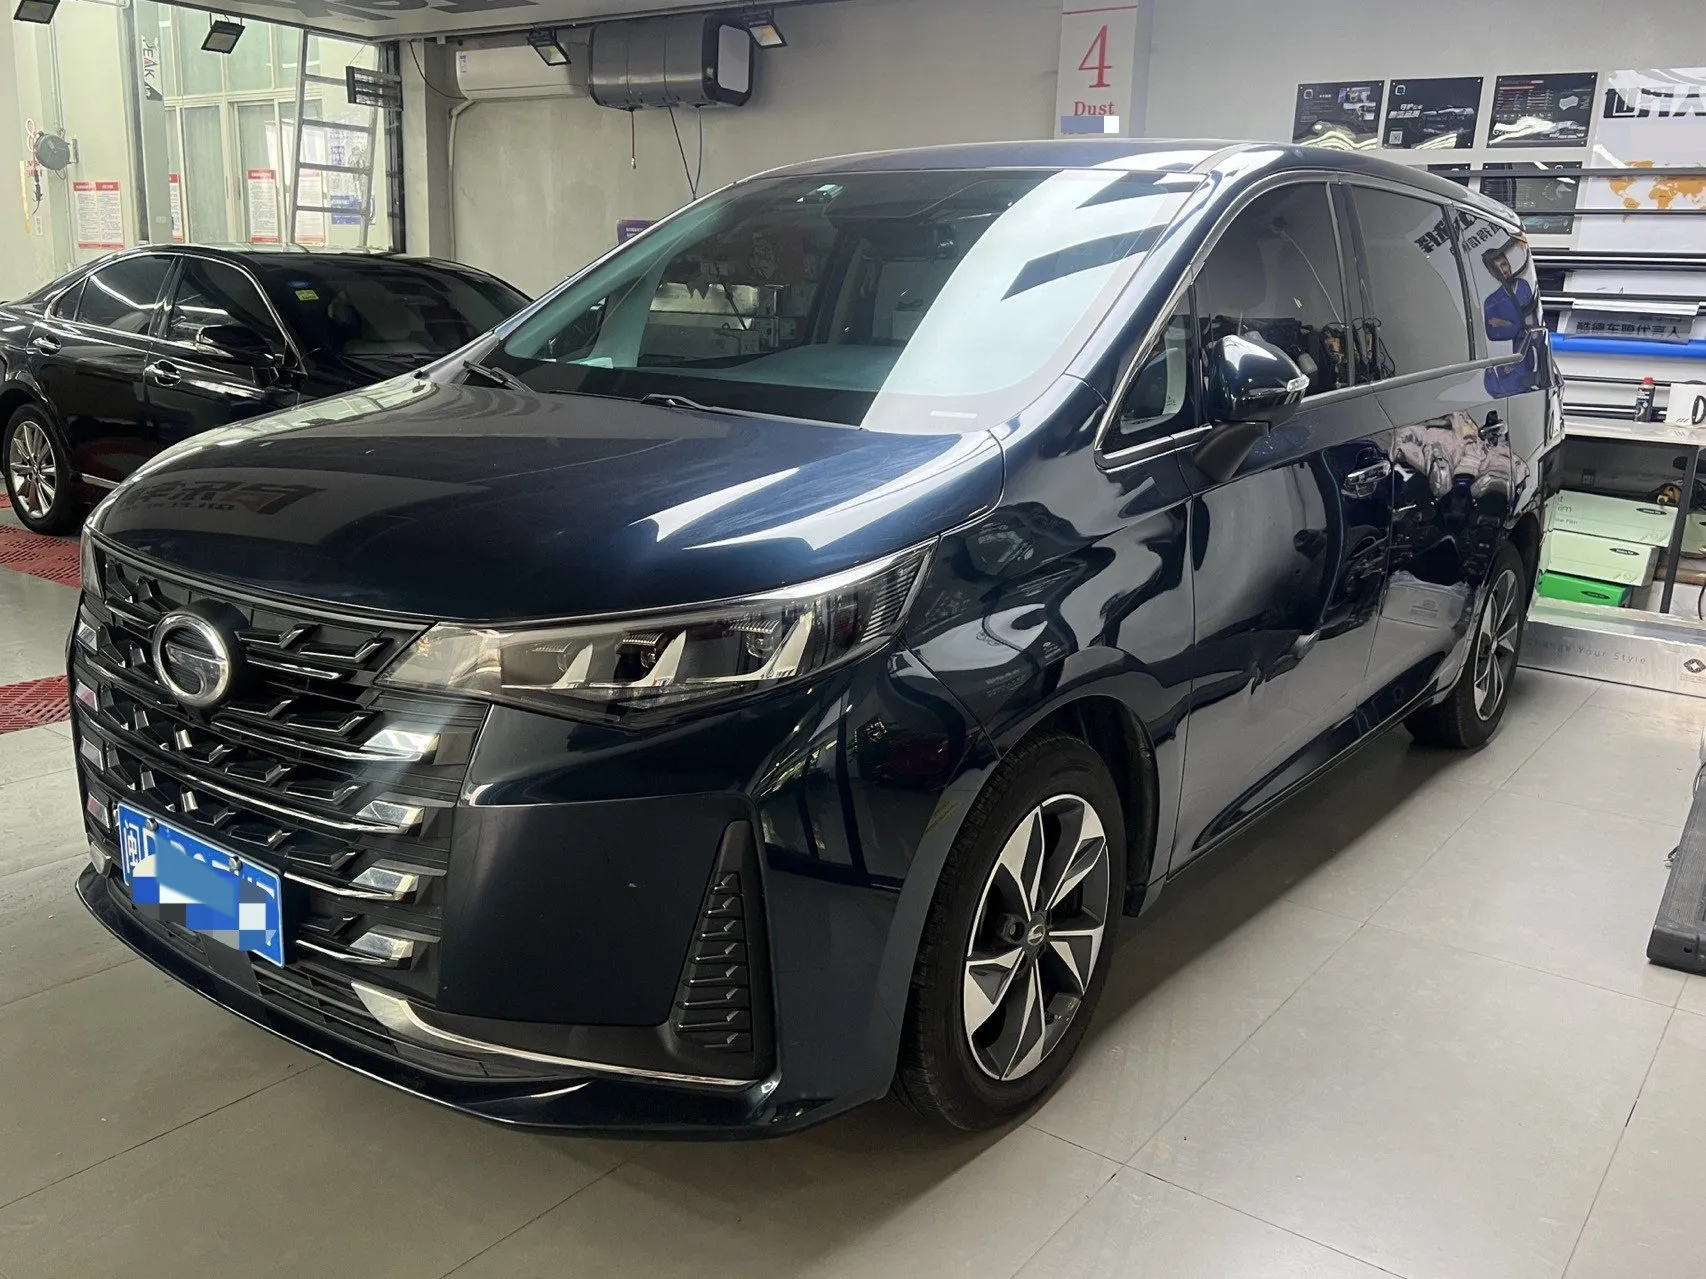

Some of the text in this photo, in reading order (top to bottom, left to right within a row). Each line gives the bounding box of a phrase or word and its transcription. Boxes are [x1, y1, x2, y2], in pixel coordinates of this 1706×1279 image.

[1078, 25, 1112, 88] 4
[1073, 100, 1115, 116] Dust
[1614, 652, 1648, 665] Style
